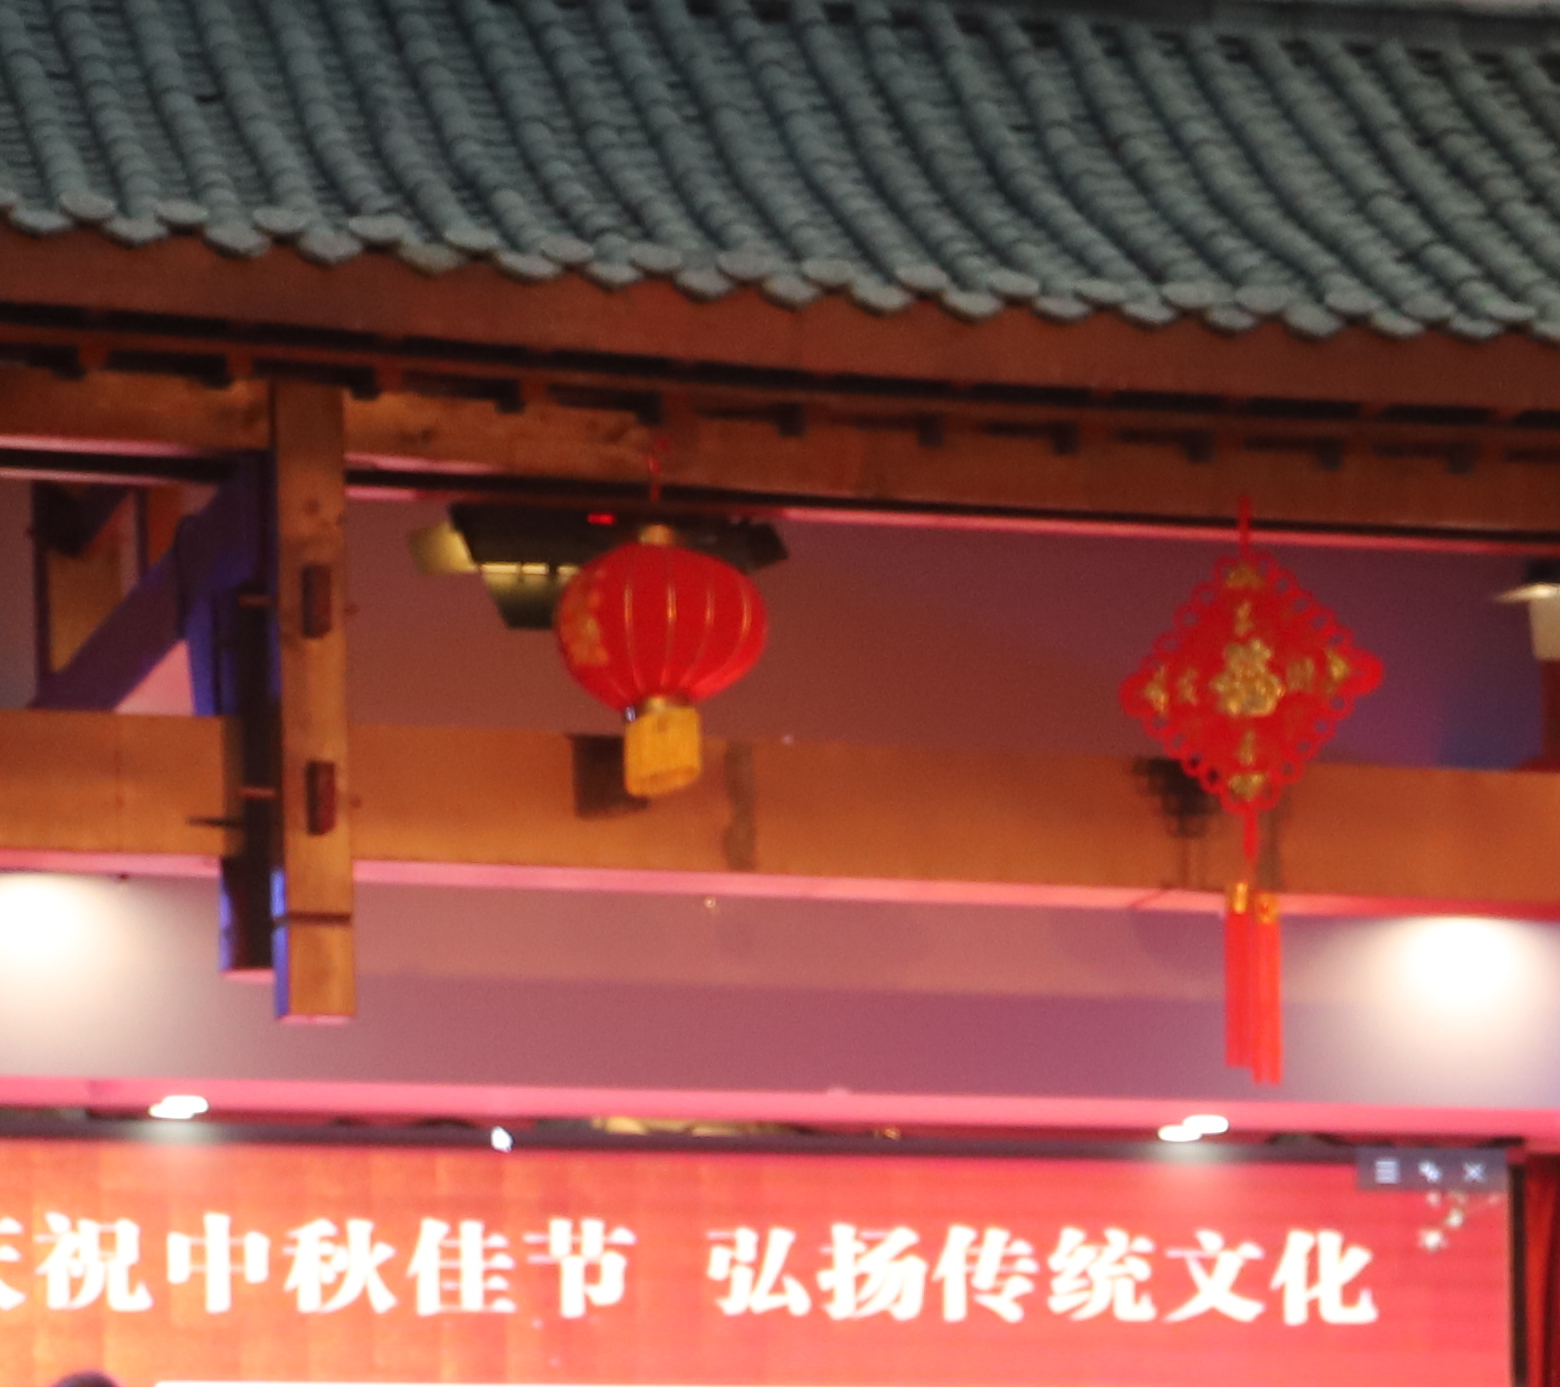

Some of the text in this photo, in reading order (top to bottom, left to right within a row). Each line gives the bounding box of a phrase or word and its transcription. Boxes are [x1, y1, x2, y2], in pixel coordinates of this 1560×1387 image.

[704, 1222, 1381, 1327] 弘扬传统文化
